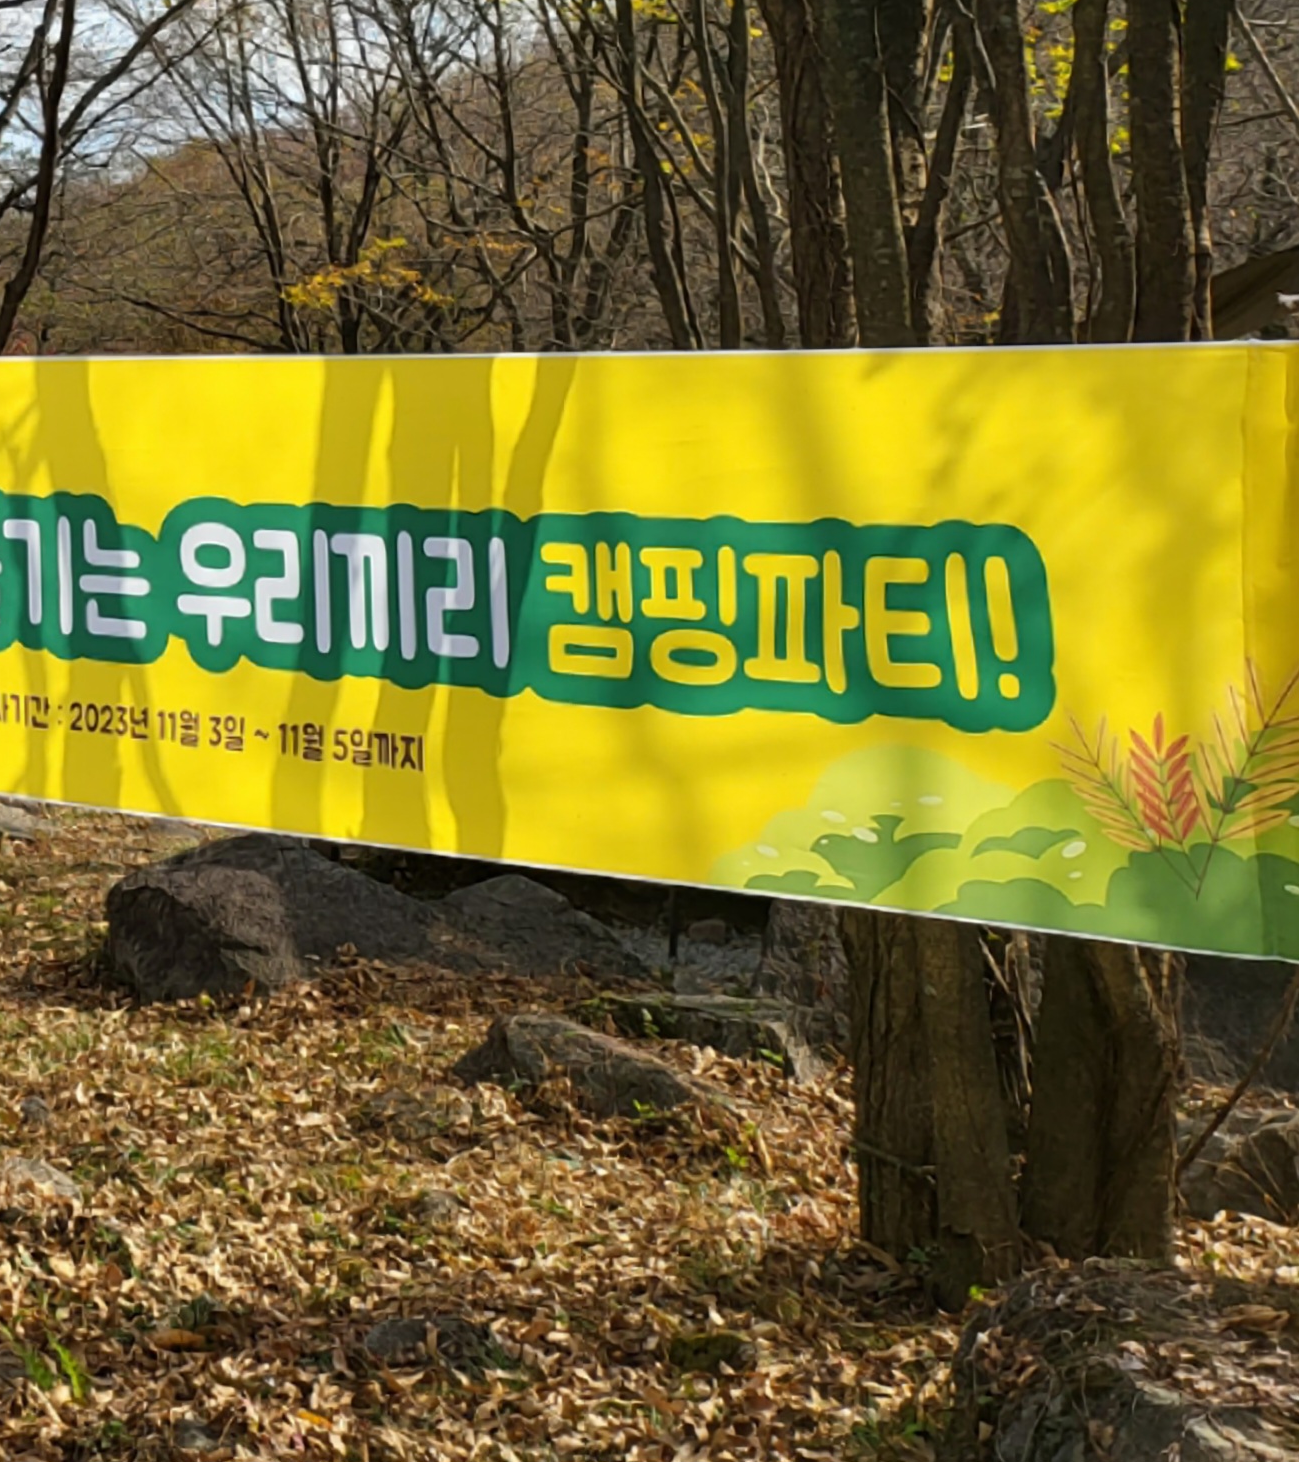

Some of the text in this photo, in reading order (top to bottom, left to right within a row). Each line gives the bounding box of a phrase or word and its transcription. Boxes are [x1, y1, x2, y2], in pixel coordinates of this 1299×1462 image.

[176, 521, 510, 669] 우리끼리
[540, 540, 1021, 701] 캠핑파티!
[69, 701, 149, 741] 2023년
[156, 709, 200, 748] 11월
[208, 715, 246, 752] 3일
[277, 722, 325, 762] 11월
[331, 728, 425, 773] 5일까지
